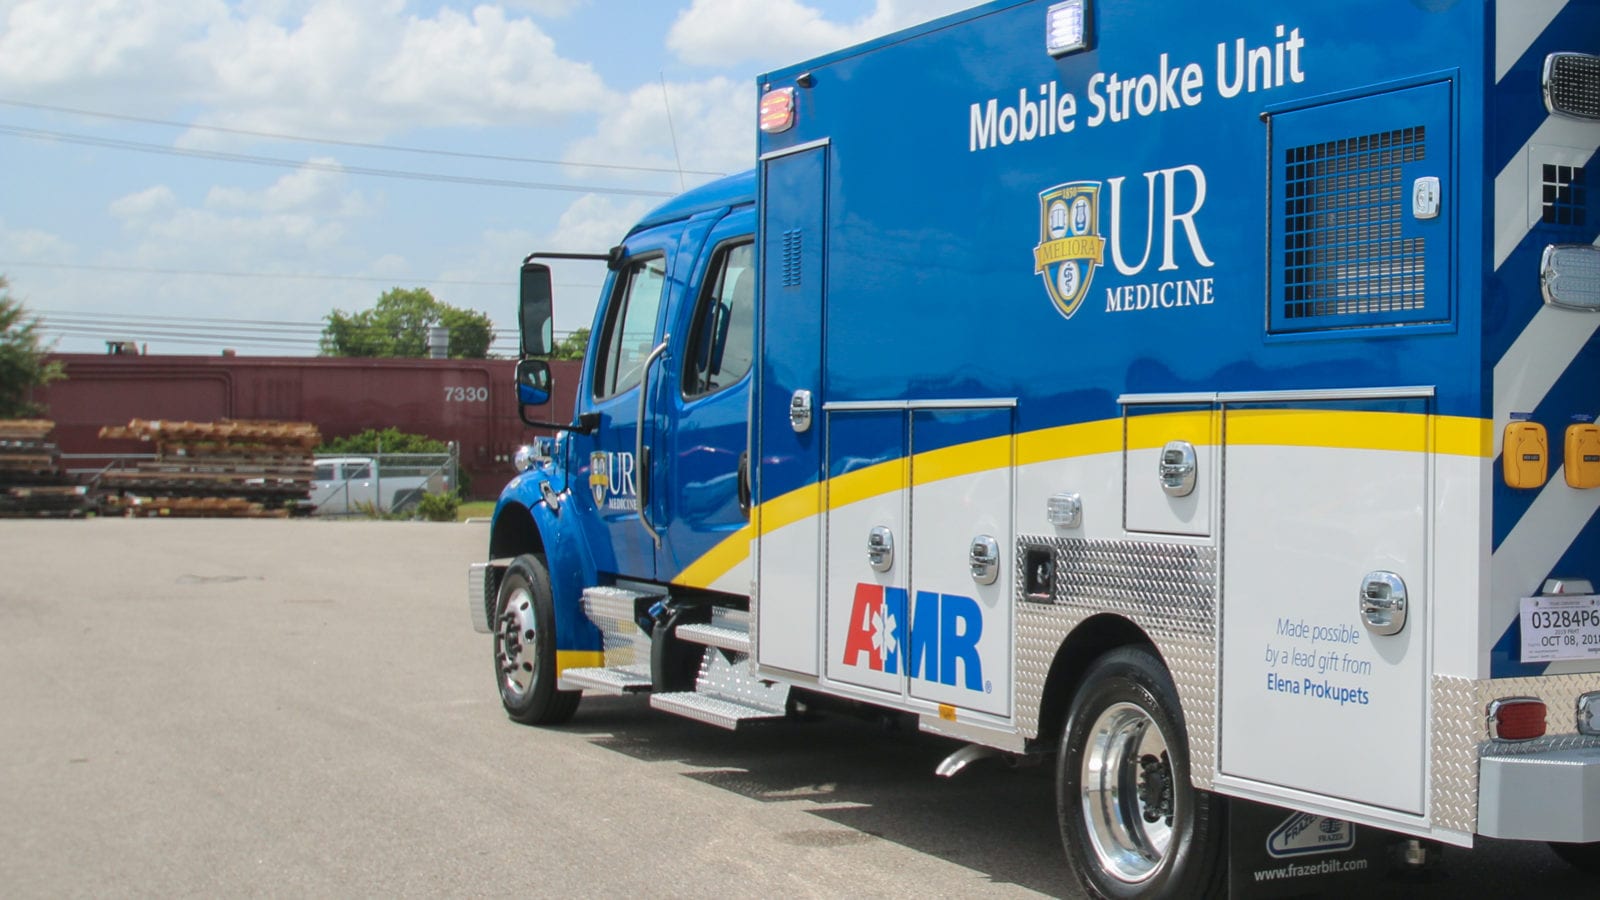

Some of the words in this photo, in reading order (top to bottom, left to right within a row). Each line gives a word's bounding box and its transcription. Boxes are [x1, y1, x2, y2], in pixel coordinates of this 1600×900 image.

[970, 81, 1077, 152] Mobile
[1088, 53, 1204, 127] Stroke
[1217, 24, 1305, 98] Unit
[1106, 163, 1215, 276] UR
[1042, 237, 1096, 262] MELIORA
[1105, 277, 1215, 312] MEDICINE
[443, 386, 489, 402] 7330
[608, 451, 637, 496] UR
[1276, 617, 1310, 639] Made
[1312, 623, 1360, 645] possible
[1531, 609, 1600, 629] 03284P6
[843, 582, 984, 692] AMR
[1541, 635, 1561, 647] OCT
[1563, 635, 1579, 647] 08,
[1581, 634, 1600, 645] 201
[1265, 643, 1280, 667] by
[1281, 650, 1289, 664] a
[1291, 647, 1317, 668] lead
[1318, 651, 1340, 674] gift
[1342, 653, 1372, 676] from
[1267, 672, 1300, 695] Elena
[1303, 678, 1369, 706] Prokupets
[1253, 858, 1369, 881] www.frazerbilt.com
